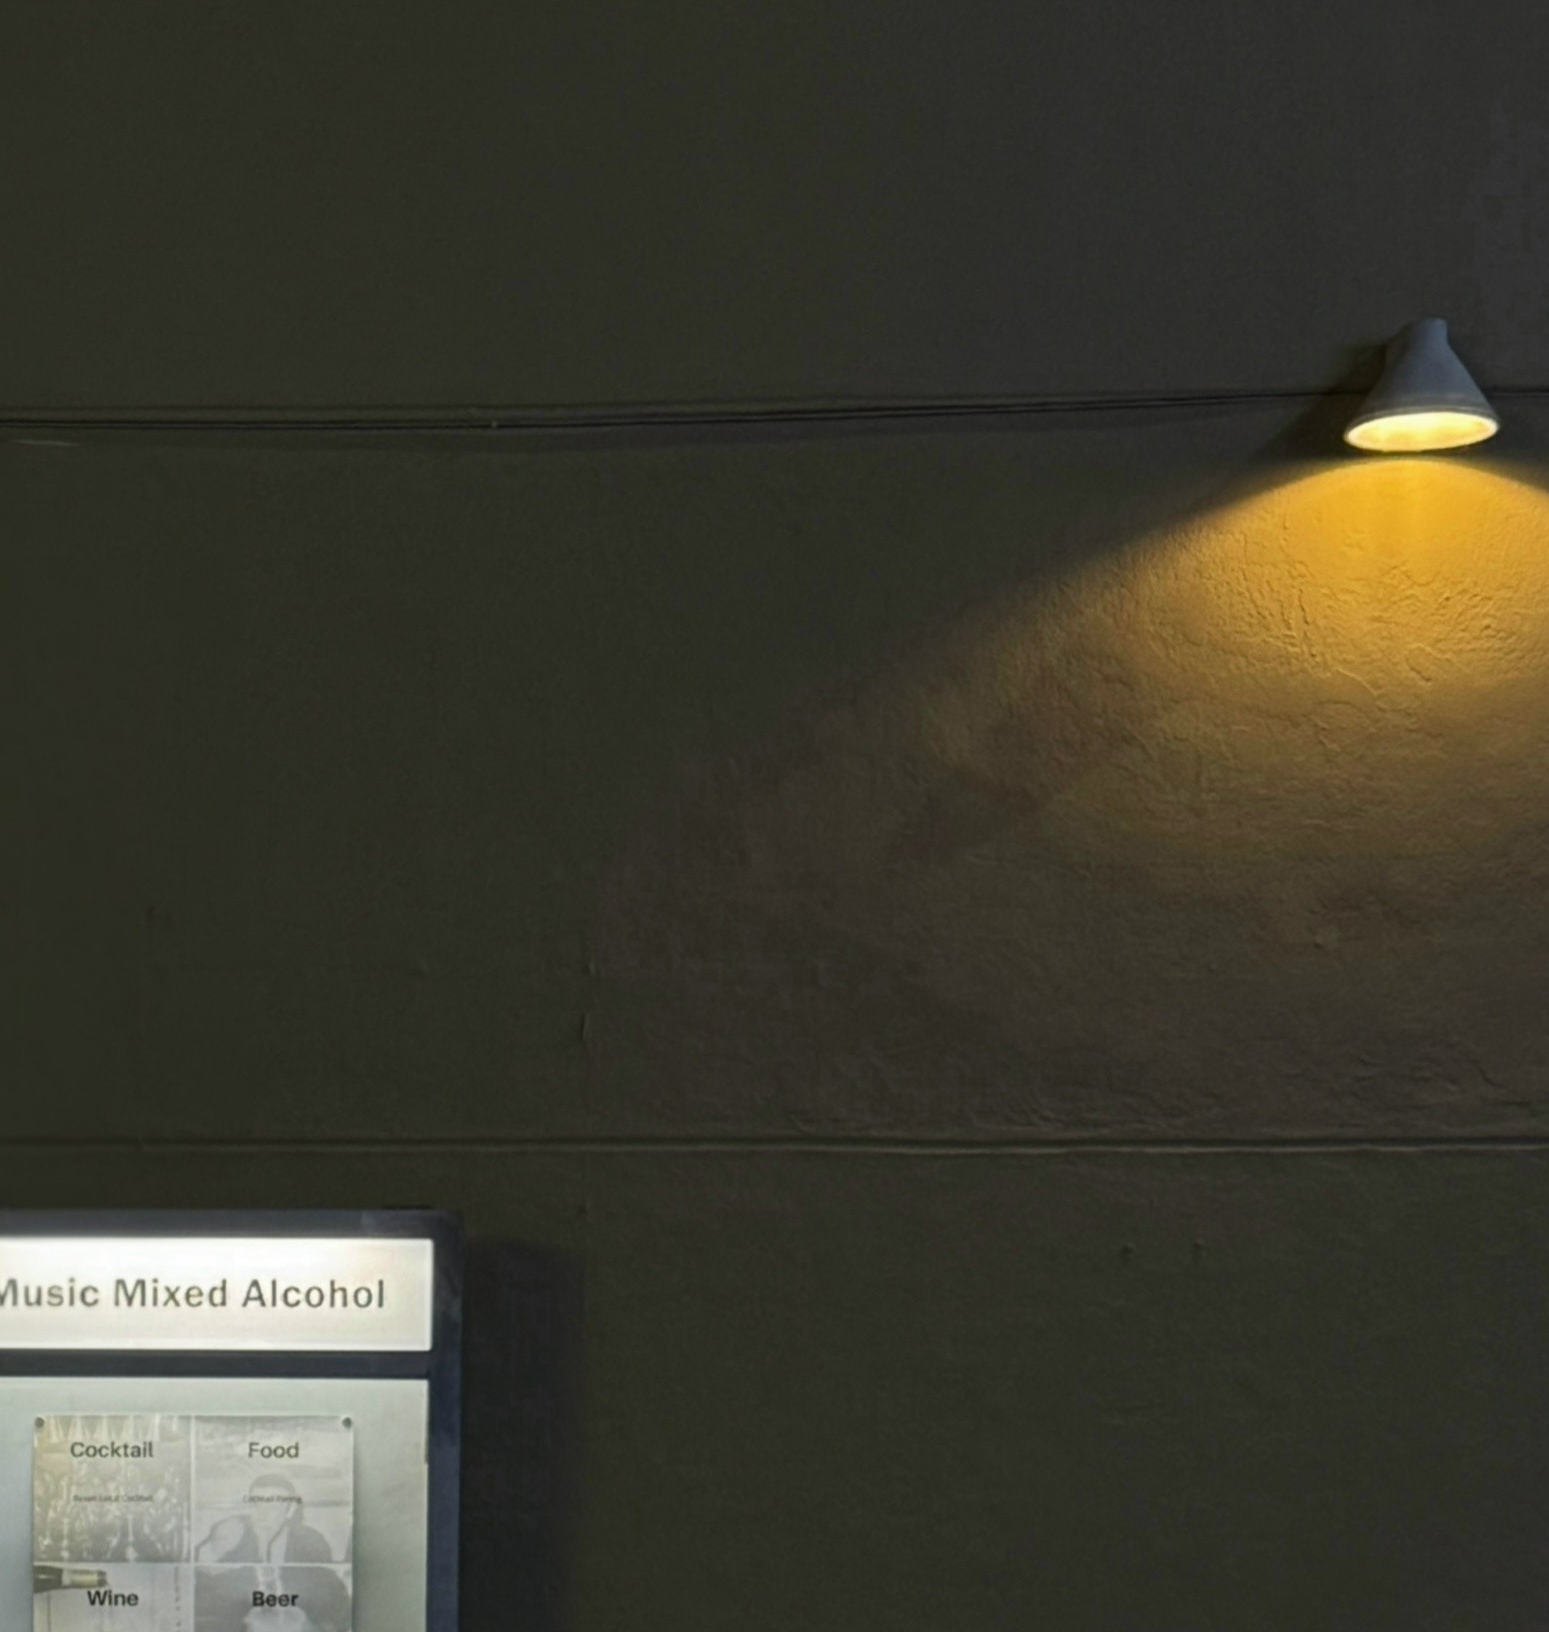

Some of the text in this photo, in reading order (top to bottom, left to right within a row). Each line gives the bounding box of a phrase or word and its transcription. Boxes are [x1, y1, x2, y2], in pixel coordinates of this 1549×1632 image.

[114, 1278, 228, 1309] Mixed
[241, 1278, 386, 1309] Alcohol
[69, 1441, 154, 1459] Cocktail
[247, 1441, 300, 1459] Food
[86, 1589, 139, 1607] Wine
[251, 1590, 299, 1608] Beer
